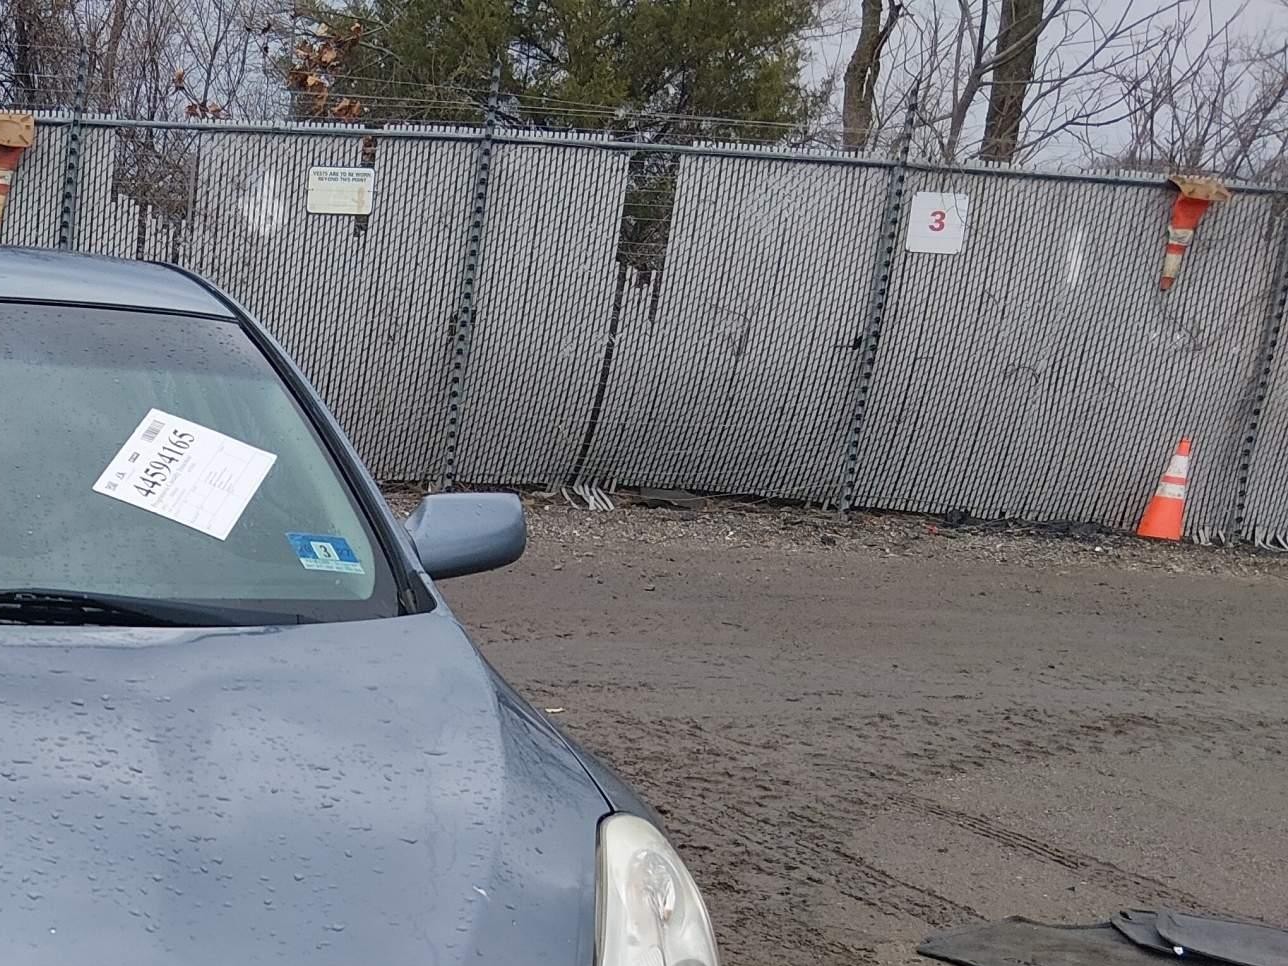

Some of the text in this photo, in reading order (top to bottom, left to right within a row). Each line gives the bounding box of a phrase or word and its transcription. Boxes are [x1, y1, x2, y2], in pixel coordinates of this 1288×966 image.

[928, 210, 946, 232] 3
[133, 429, 195, 498] 44594165
[319, 544, 332, 558] 3
